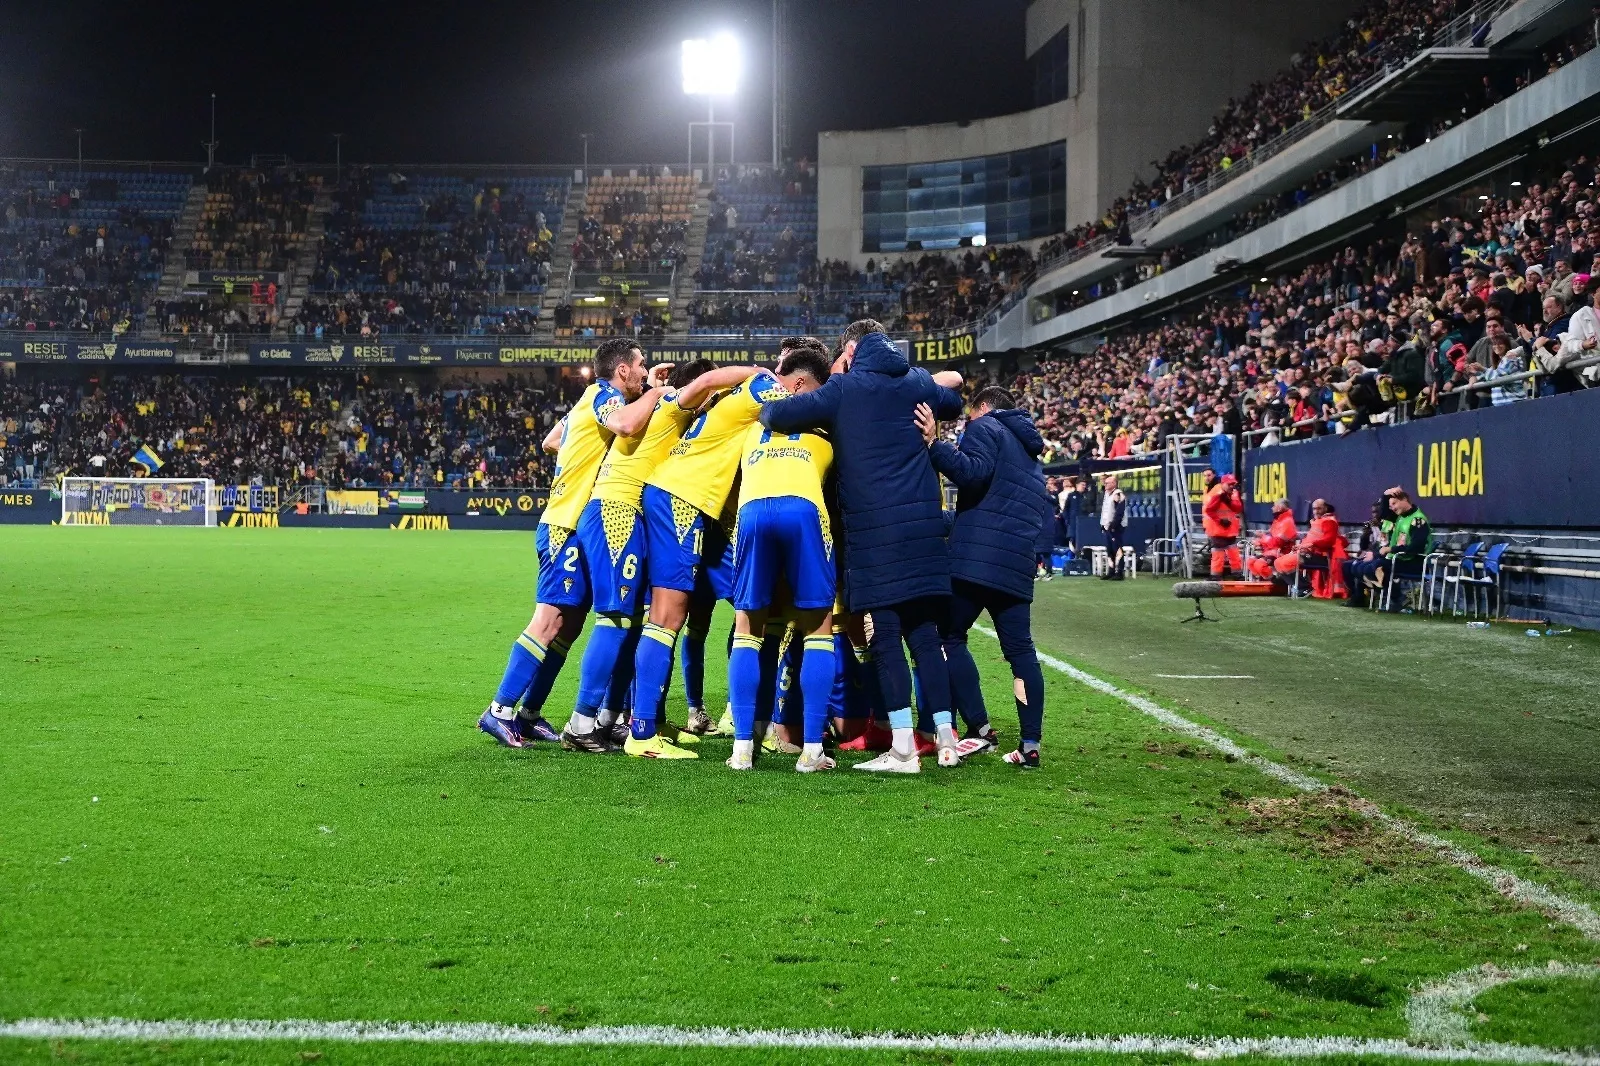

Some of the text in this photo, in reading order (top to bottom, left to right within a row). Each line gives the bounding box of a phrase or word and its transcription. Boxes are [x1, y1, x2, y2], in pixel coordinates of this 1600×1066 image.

[24, 342, 68, 354] RESET
[124, 347, 174, 358] Ayuntamiento
[260, 348, 292, 359] de Cádiz
[353, 346, 396, 357] RESET
[914, 334, 974, 361] TELENO
[663, 351, 749, 361] MILAR MILAR
[766, 451, 810, 463] PASCUAL
[1417, 437, 1484, 497] LALIGA
[1253, 462, 1288, 503] LALIGA
[242, 513, 279, 527] JOYMA
[411, 515, 449, 530] JOYMA
[563, 546, 579, 572] 2
[622, 553, 638, 580] 6
[779, 666, 794, 691] 5
